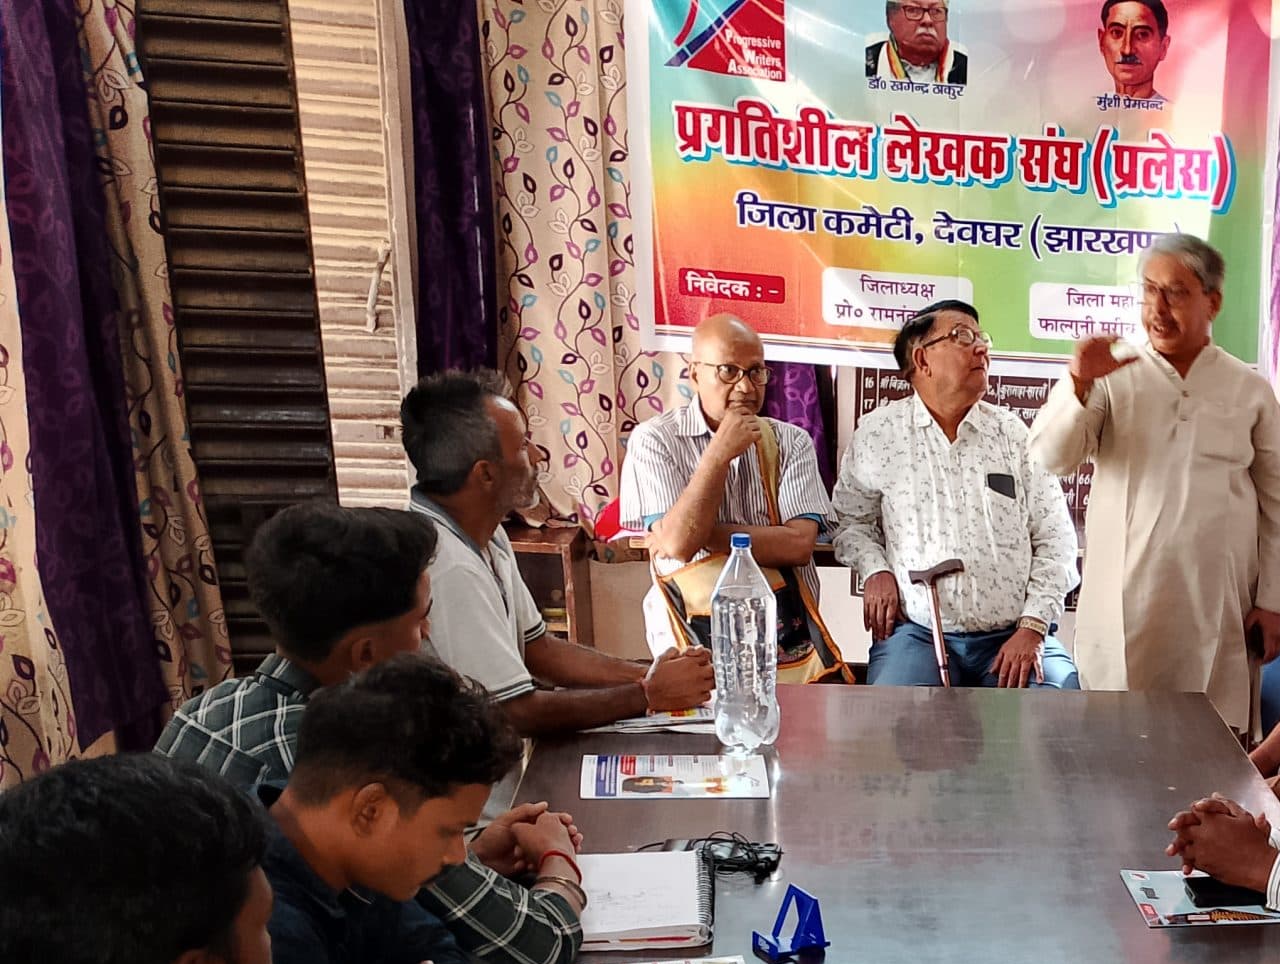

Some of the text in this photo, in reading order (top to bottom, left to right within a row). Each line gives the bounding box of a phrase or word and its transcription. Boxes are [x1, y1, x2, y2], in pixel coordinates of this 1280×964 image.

[725, 28, 782, 50] Progressive
[744, 48, 781, 67] Writers
[728, 61, 782, 80] Association
[674, 99, 1230, 206] प्रगतिशील लेखक संघ (प्रलेस)
[735, 192, 1023, 248] जिला कमेटी, देवघर
[685, 271, 751, 298] निवेदक
[860, 274, 935, 298] जिलाध्यक्ष
[1067, 287, 1105, 308] जिला
